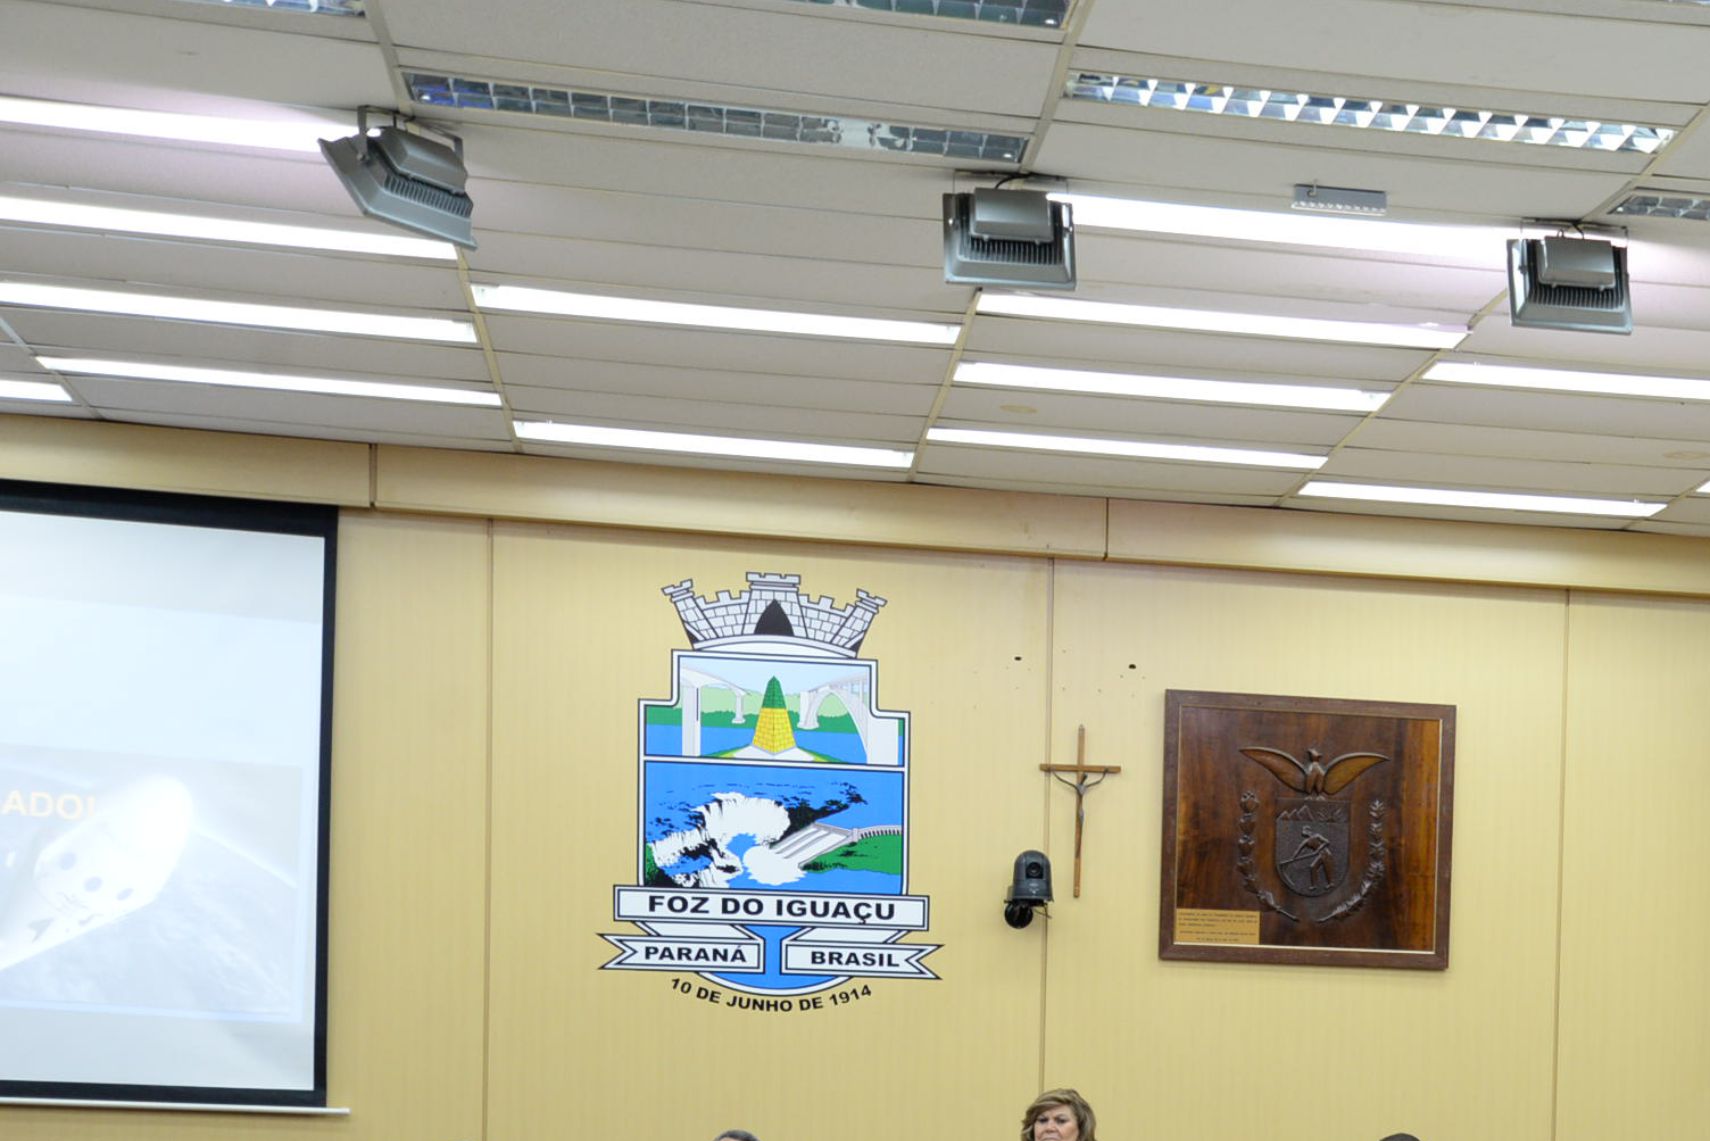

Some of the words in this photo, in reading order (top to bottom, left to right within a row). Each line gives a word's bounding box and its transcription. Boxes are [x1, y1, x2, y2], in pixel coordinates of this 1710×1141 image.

[648, 895, 710, 915] FOZ
[721, 897, 764, 917] DO
[776, 899, 896, 925] IGUAÇU
[644, 945, 747, 963] PARANÁ
[810, 951, 900, 967] BRASIL
[671, 978, 692, 994] 10
[696, 986, 722, 1003] DE
[726, 995, 793, 1012] JUNHO
[798, 996, 824, 1011] DE
[829, 984, 872, 1006] 1914
